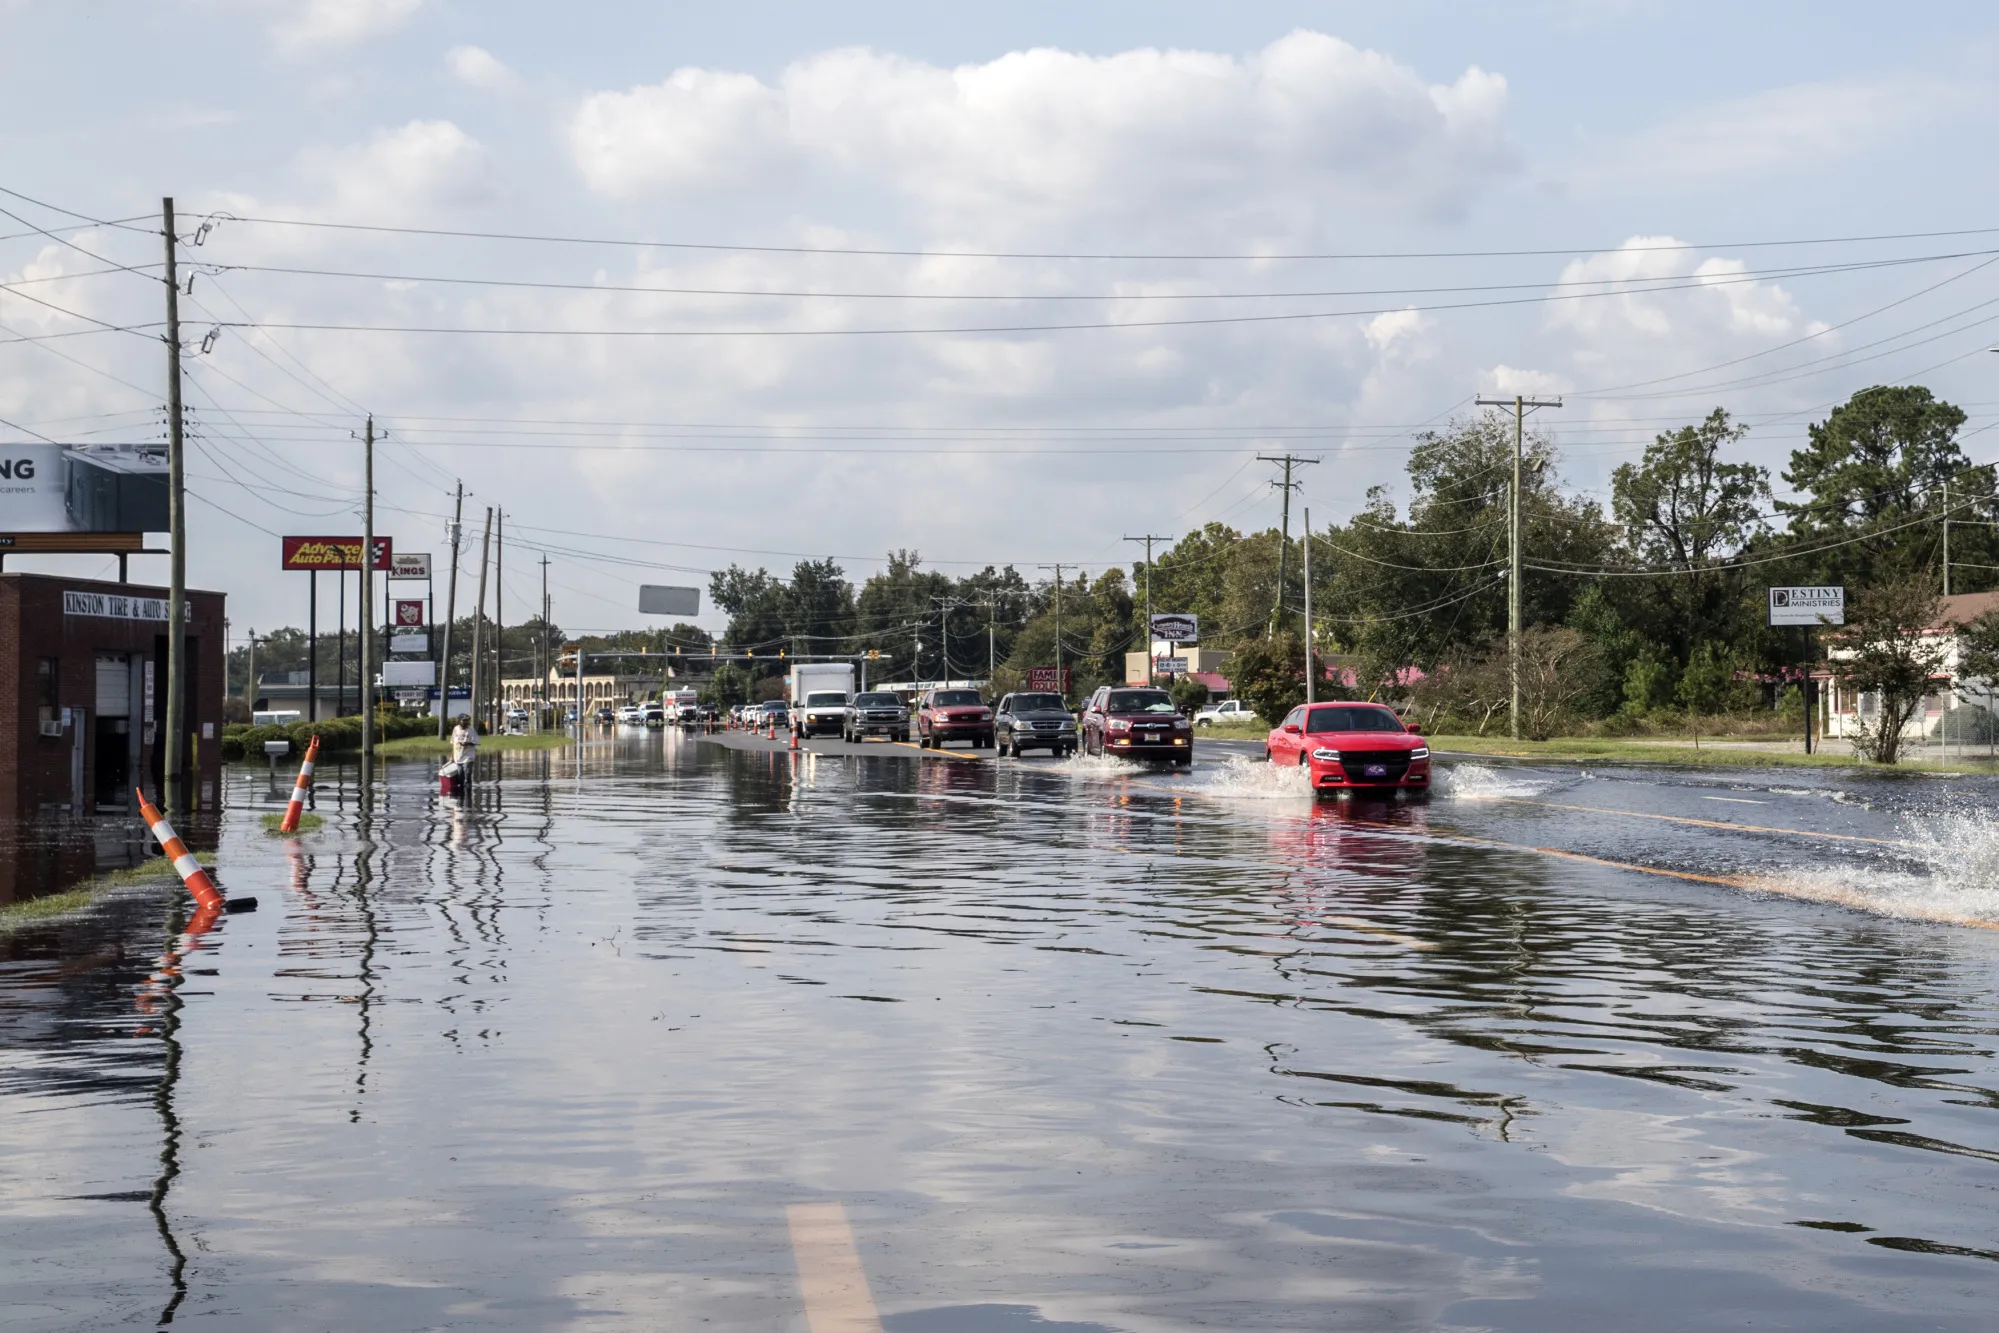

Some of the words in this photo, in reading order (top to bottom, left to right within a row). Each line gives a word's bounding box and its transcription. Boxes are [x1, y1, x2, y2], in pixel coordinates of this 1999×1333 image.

[289, 554, 322, 564] Auto
[392, 566, 426, 577] KINGS
[65, 593, 104, 615] KINSTON
[109, 597, 128, 616] TIRE
[133, 599, 139, 617] &
[143, 600, 161, 619] AUTO
[1033, 669, 1067, 680] FAMIY
